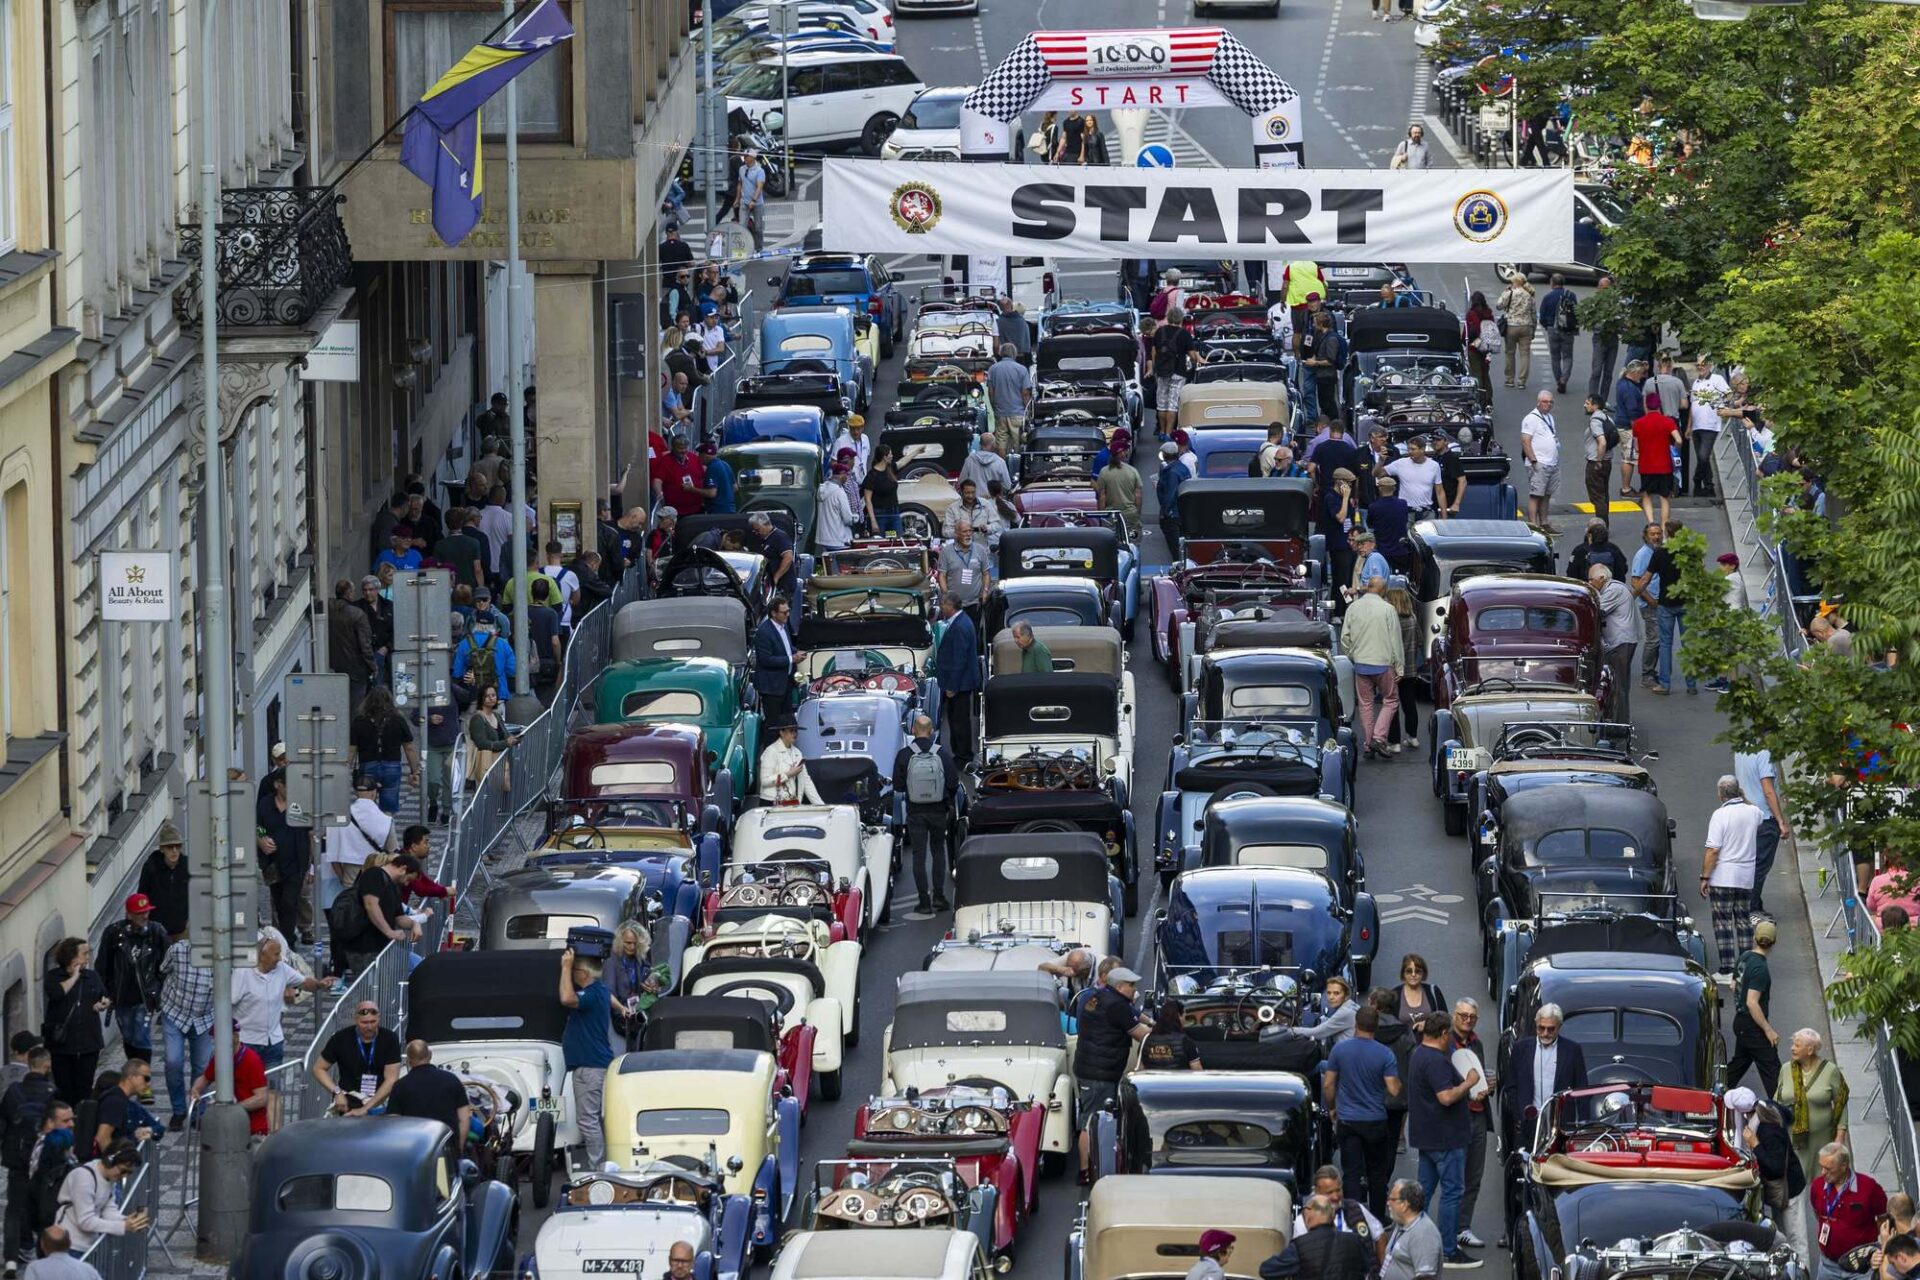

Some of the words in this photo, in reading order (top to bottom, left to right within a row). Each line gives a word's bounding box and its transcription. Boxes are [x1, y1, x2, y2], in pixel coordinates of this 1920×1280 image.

[1092, 44, 1166, 64] 1000
[1071, 85, 1189, 105] START
[1011, 183, 1384, 244] START
[108, 586, 124, 597] All
[127, 586, 163, 597] About
[108, 597, 133, 606] Beauty
[1452, 760, 1473, 768] 4399
